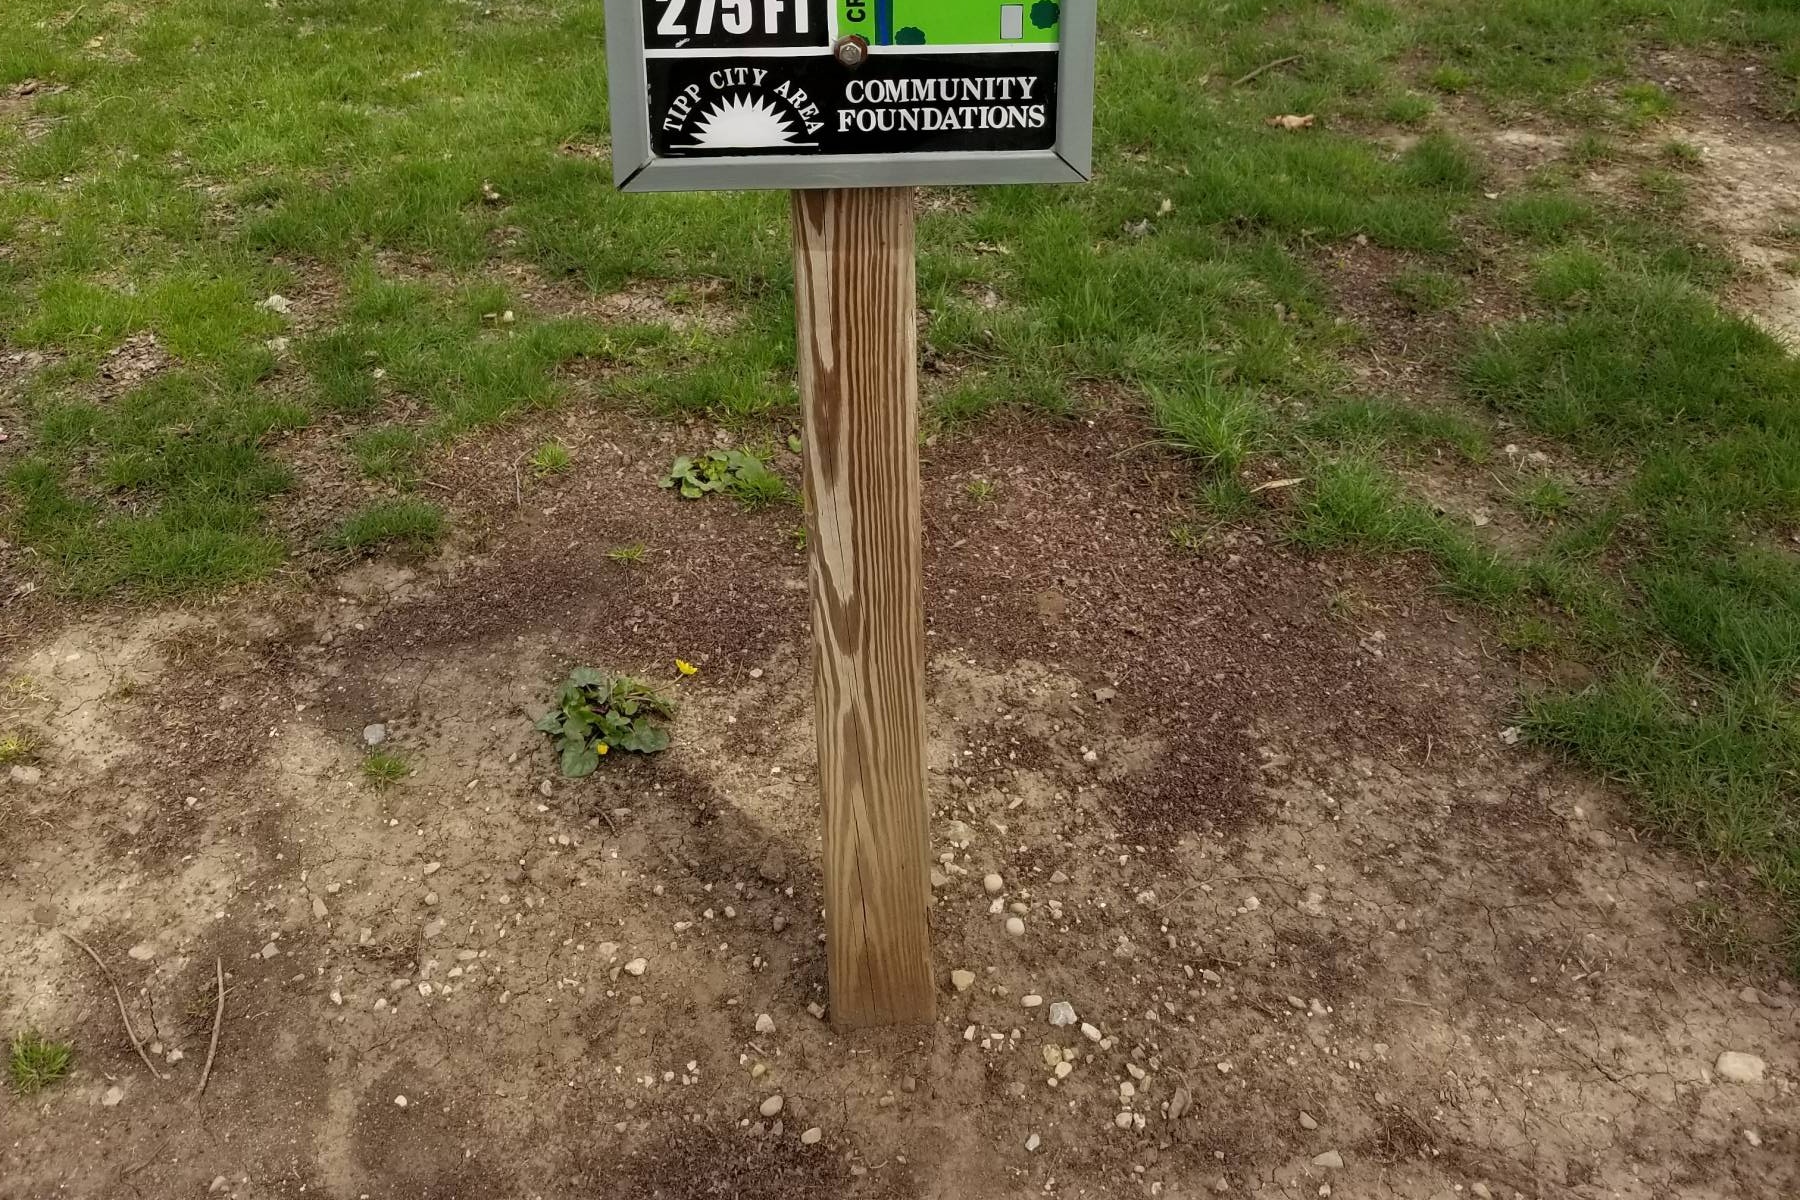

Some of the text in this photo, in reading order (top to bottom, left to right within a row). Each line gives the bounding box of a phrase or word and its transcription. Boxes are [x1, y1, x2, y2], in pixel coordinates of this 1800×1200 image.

[662, 67, 825, 135] TIPP CITY AREA
[845, 76, 1038, 104] COMMUNITY
[837, 104, 1046, 132] FOUNDATIONS
